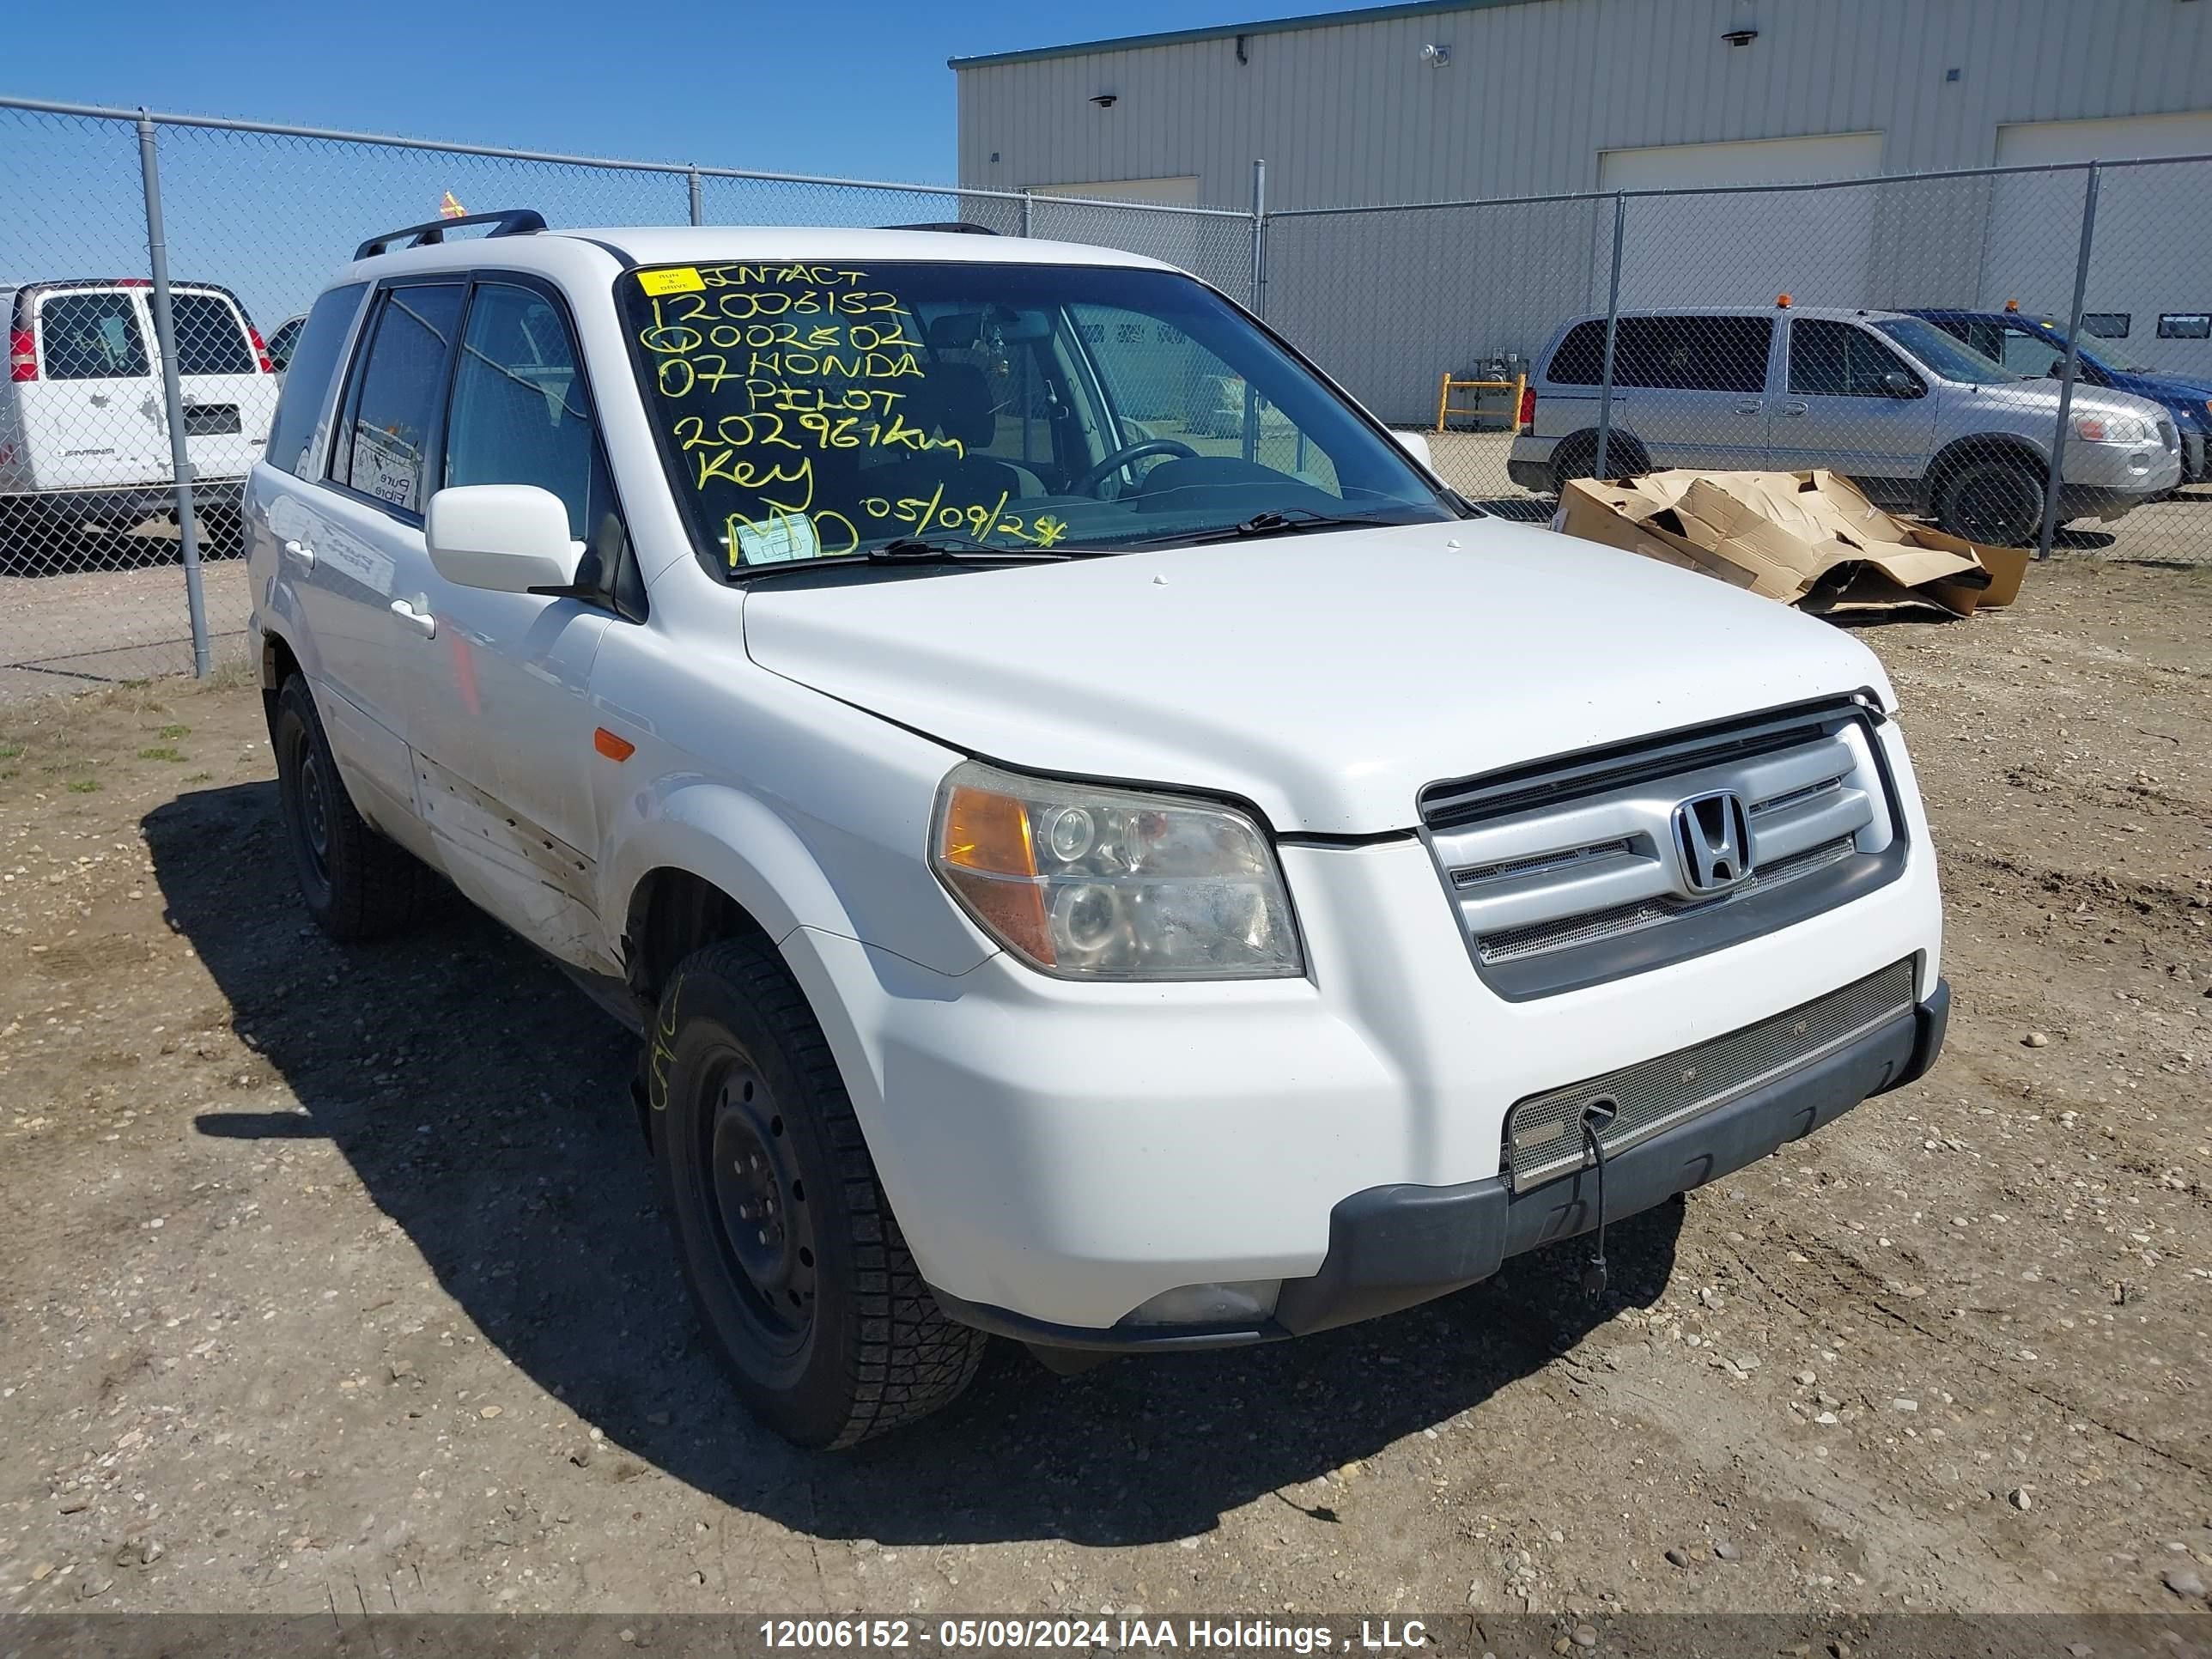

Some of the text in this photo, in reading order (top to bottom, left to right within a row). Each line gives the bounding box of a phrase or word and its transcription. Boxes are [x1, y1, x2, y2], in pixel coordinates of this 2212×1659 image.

[699, 264, 870, 287] INTACT
[652, 291, 912, 328] 12006152
[659, 352, 926, 398] 07 HONDA
[745, 379, 907, 416] PILOT
